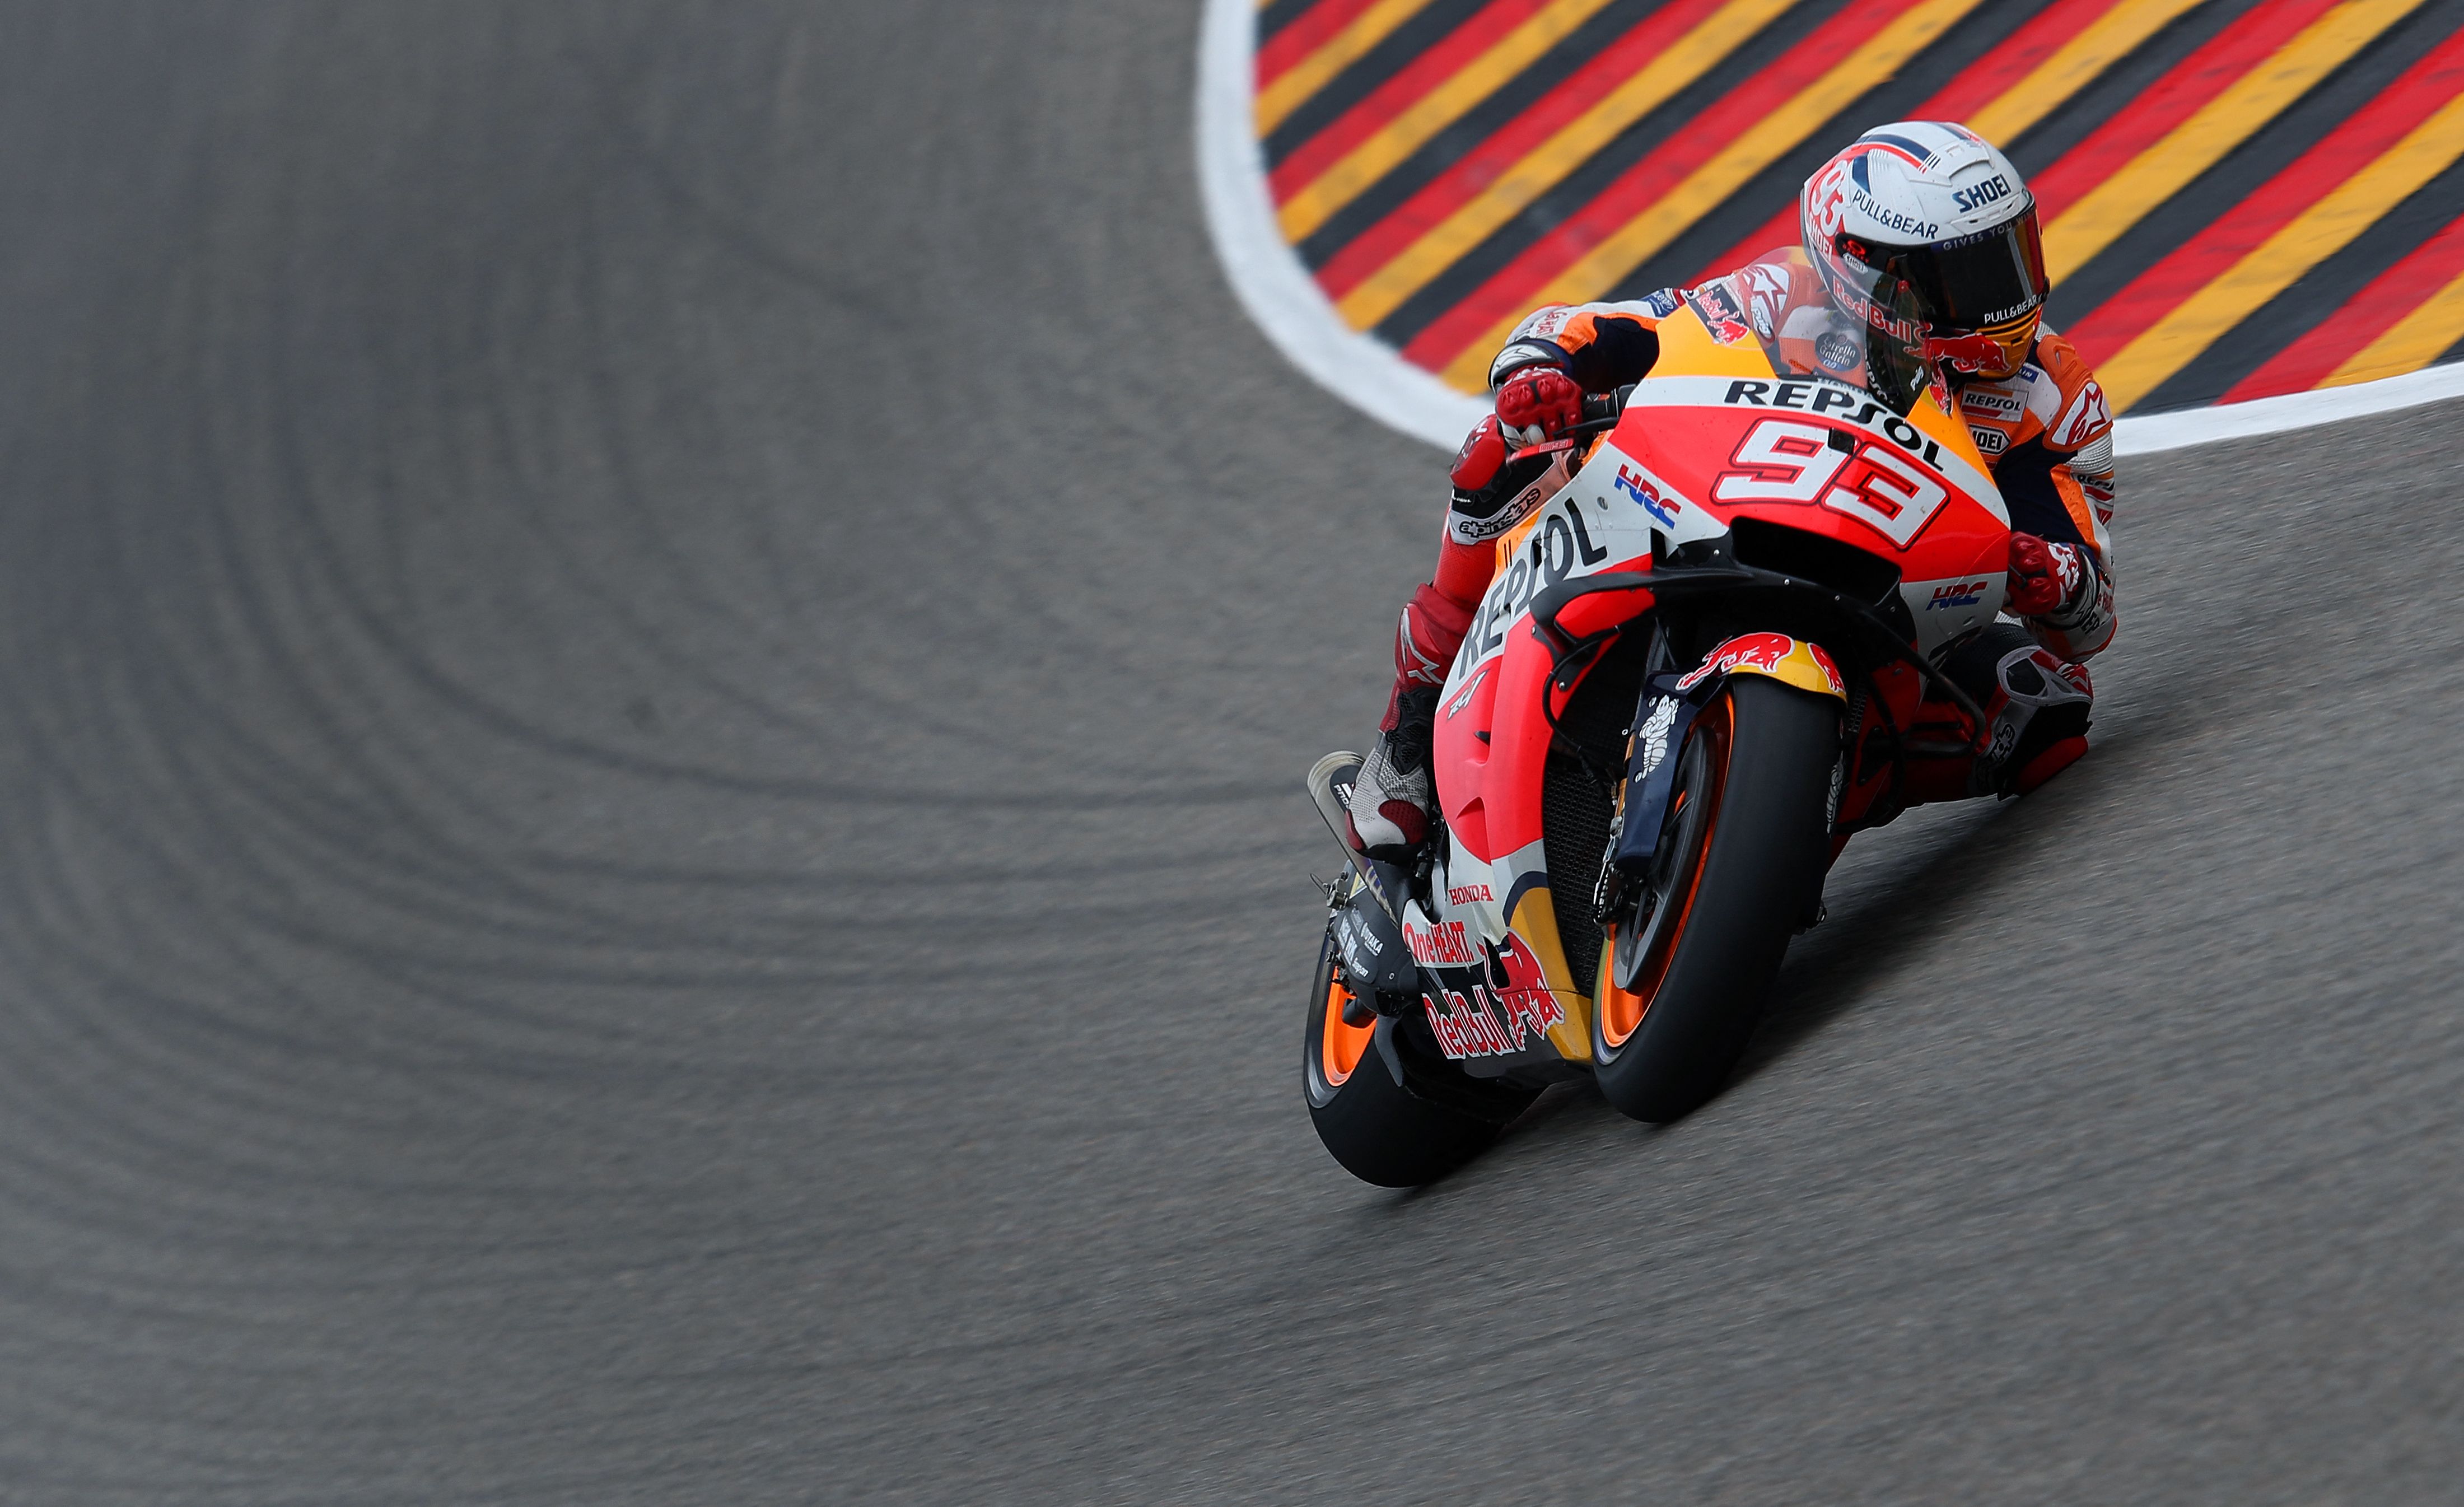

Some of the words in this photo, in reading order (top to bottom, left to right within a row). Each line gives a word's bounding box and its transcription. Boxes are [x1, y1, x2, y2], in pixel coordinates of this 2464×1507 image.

[1852, 188, 1939, 240] PULL&BEAR
[1952, 173, 2012, 213] SHOEI
[1943, 232, 1984, 250] GIVES
[1990, 222, 2013, 237] YOU
[1833, 275, 1867, 321] Red
[1869, 304, 1911, 344] Bull
[1984, 294, 2038, 325] PULL&BEAR
[1723, 380, 1945, 472] REPSOL
[1965, 393, 2021, 411] REPSOL
[1613, 463, 1682, 530] HRC
[1712, 418, 1950, 549] 93
[1459, 488, 1541, 538] alpinestars
[1458, 497, 1608, 681] REPSOL
[1925, 581, 1989, 612] HRC
[1448, 884, 1495, 906] HONDA
[1404, 922, 1435, 963] One
[1422, 988, 1481, 1059] Red
[1451, 985, 1515, 1057] Bull
